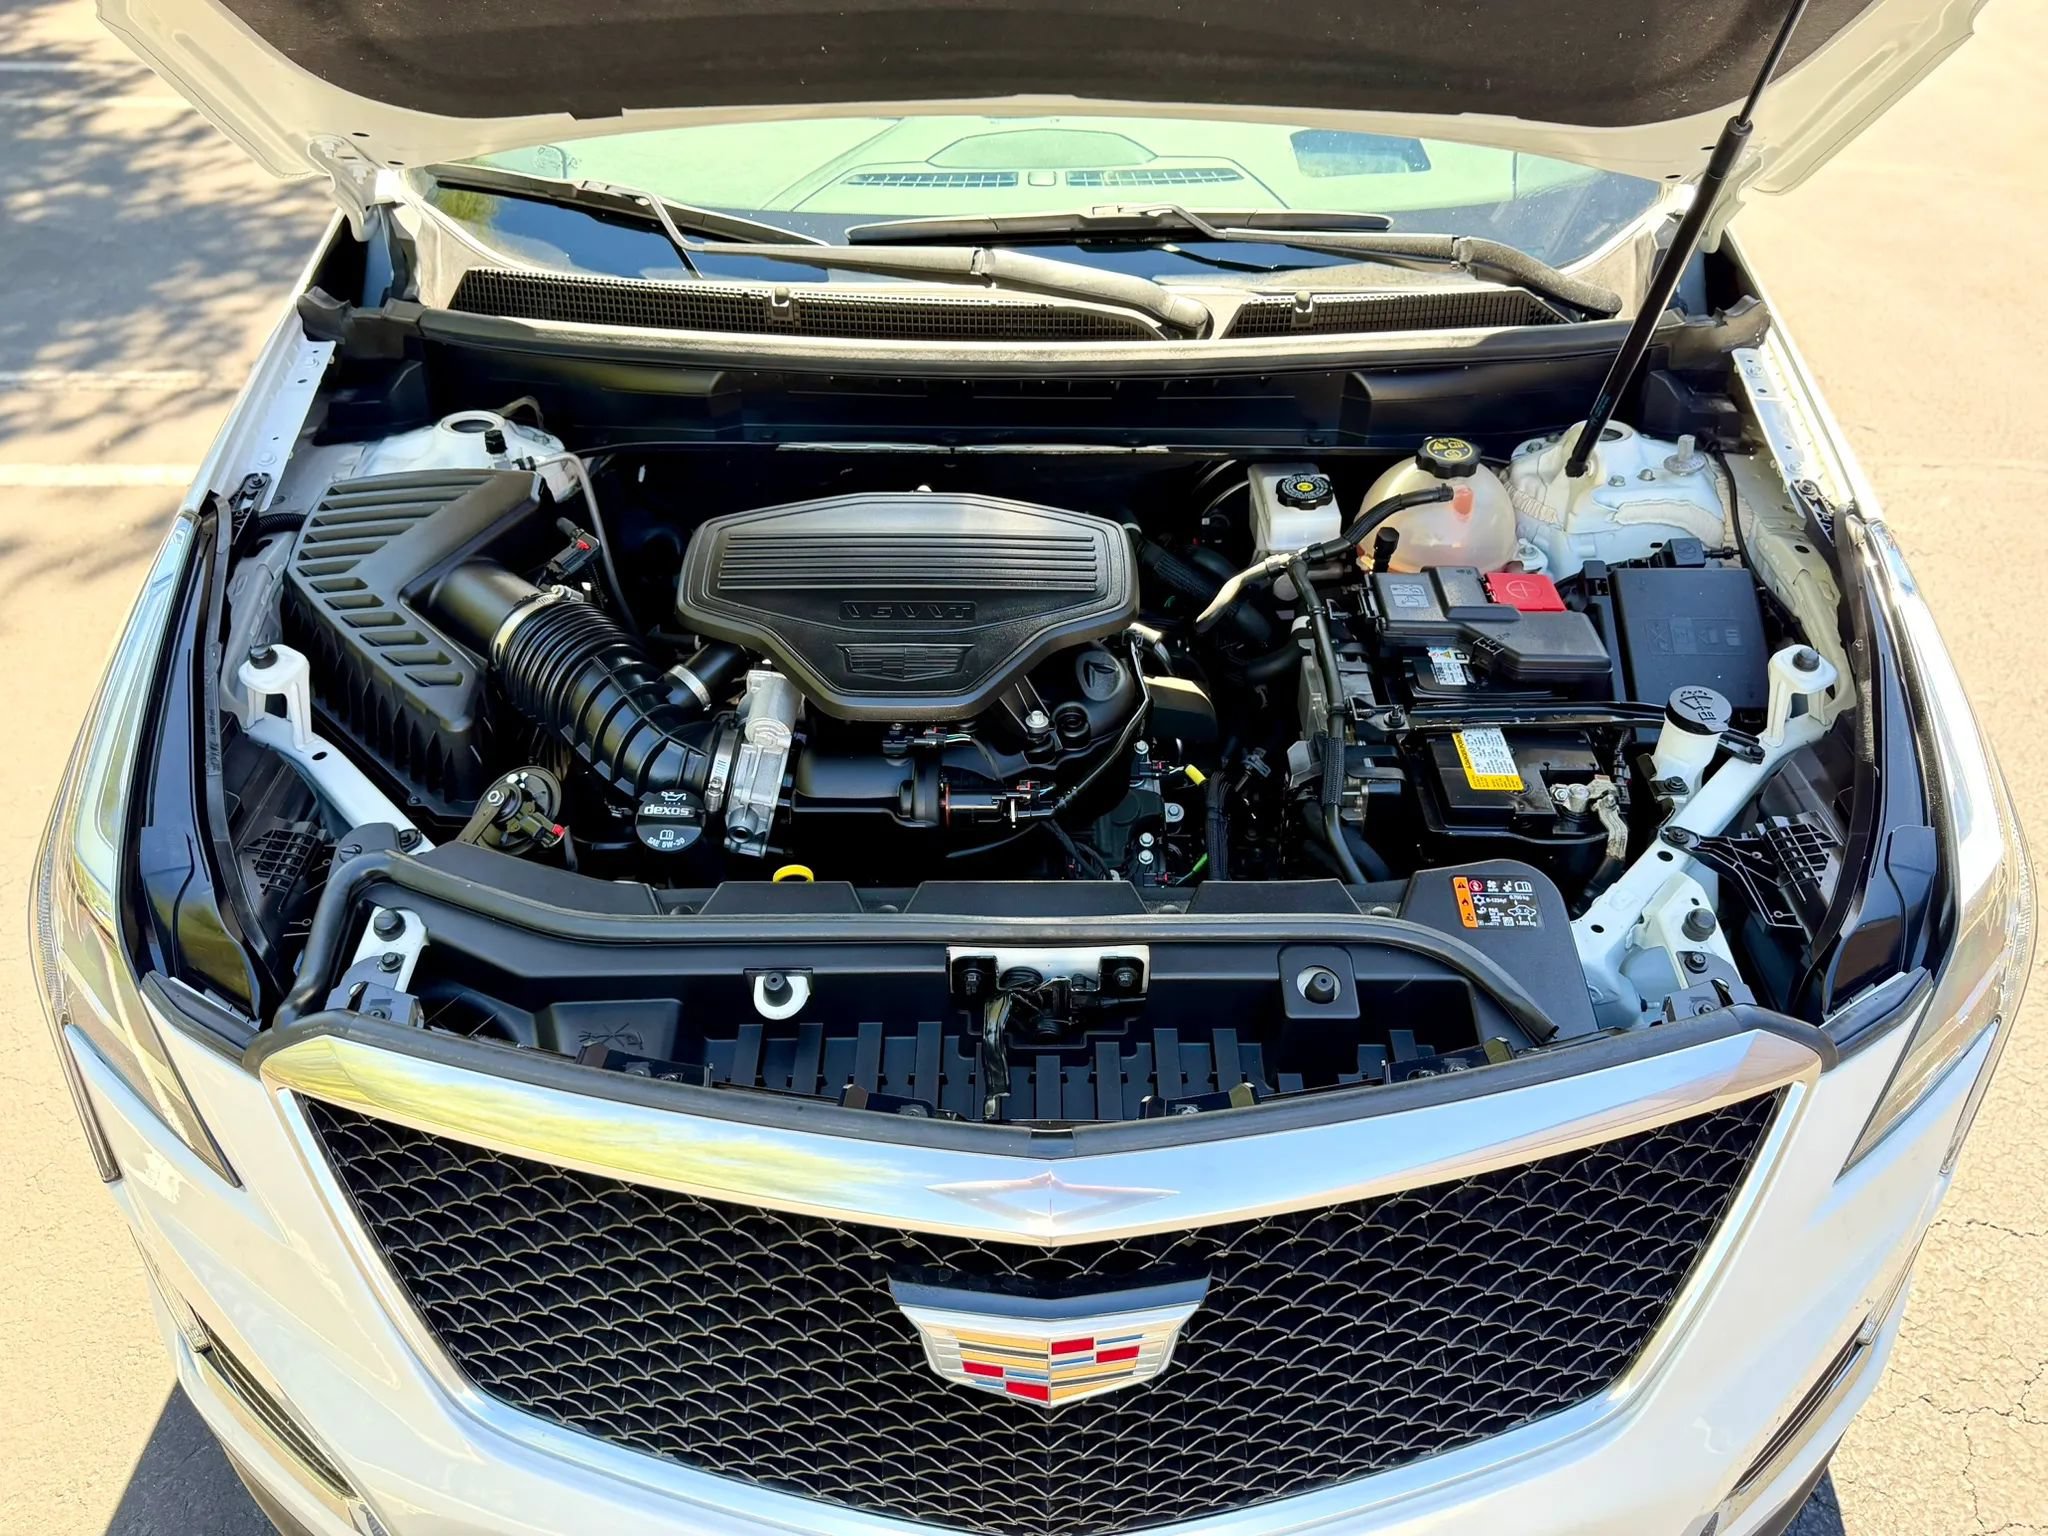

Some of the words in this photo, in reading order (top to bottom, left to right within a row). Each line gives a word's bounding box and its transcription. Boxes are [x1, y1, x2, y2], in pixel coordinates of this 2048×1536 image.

[644, 804, 689, 815] dexos
[647, 837, 659, 847] SAE
[662, 837, 685, 848] 5W-30
